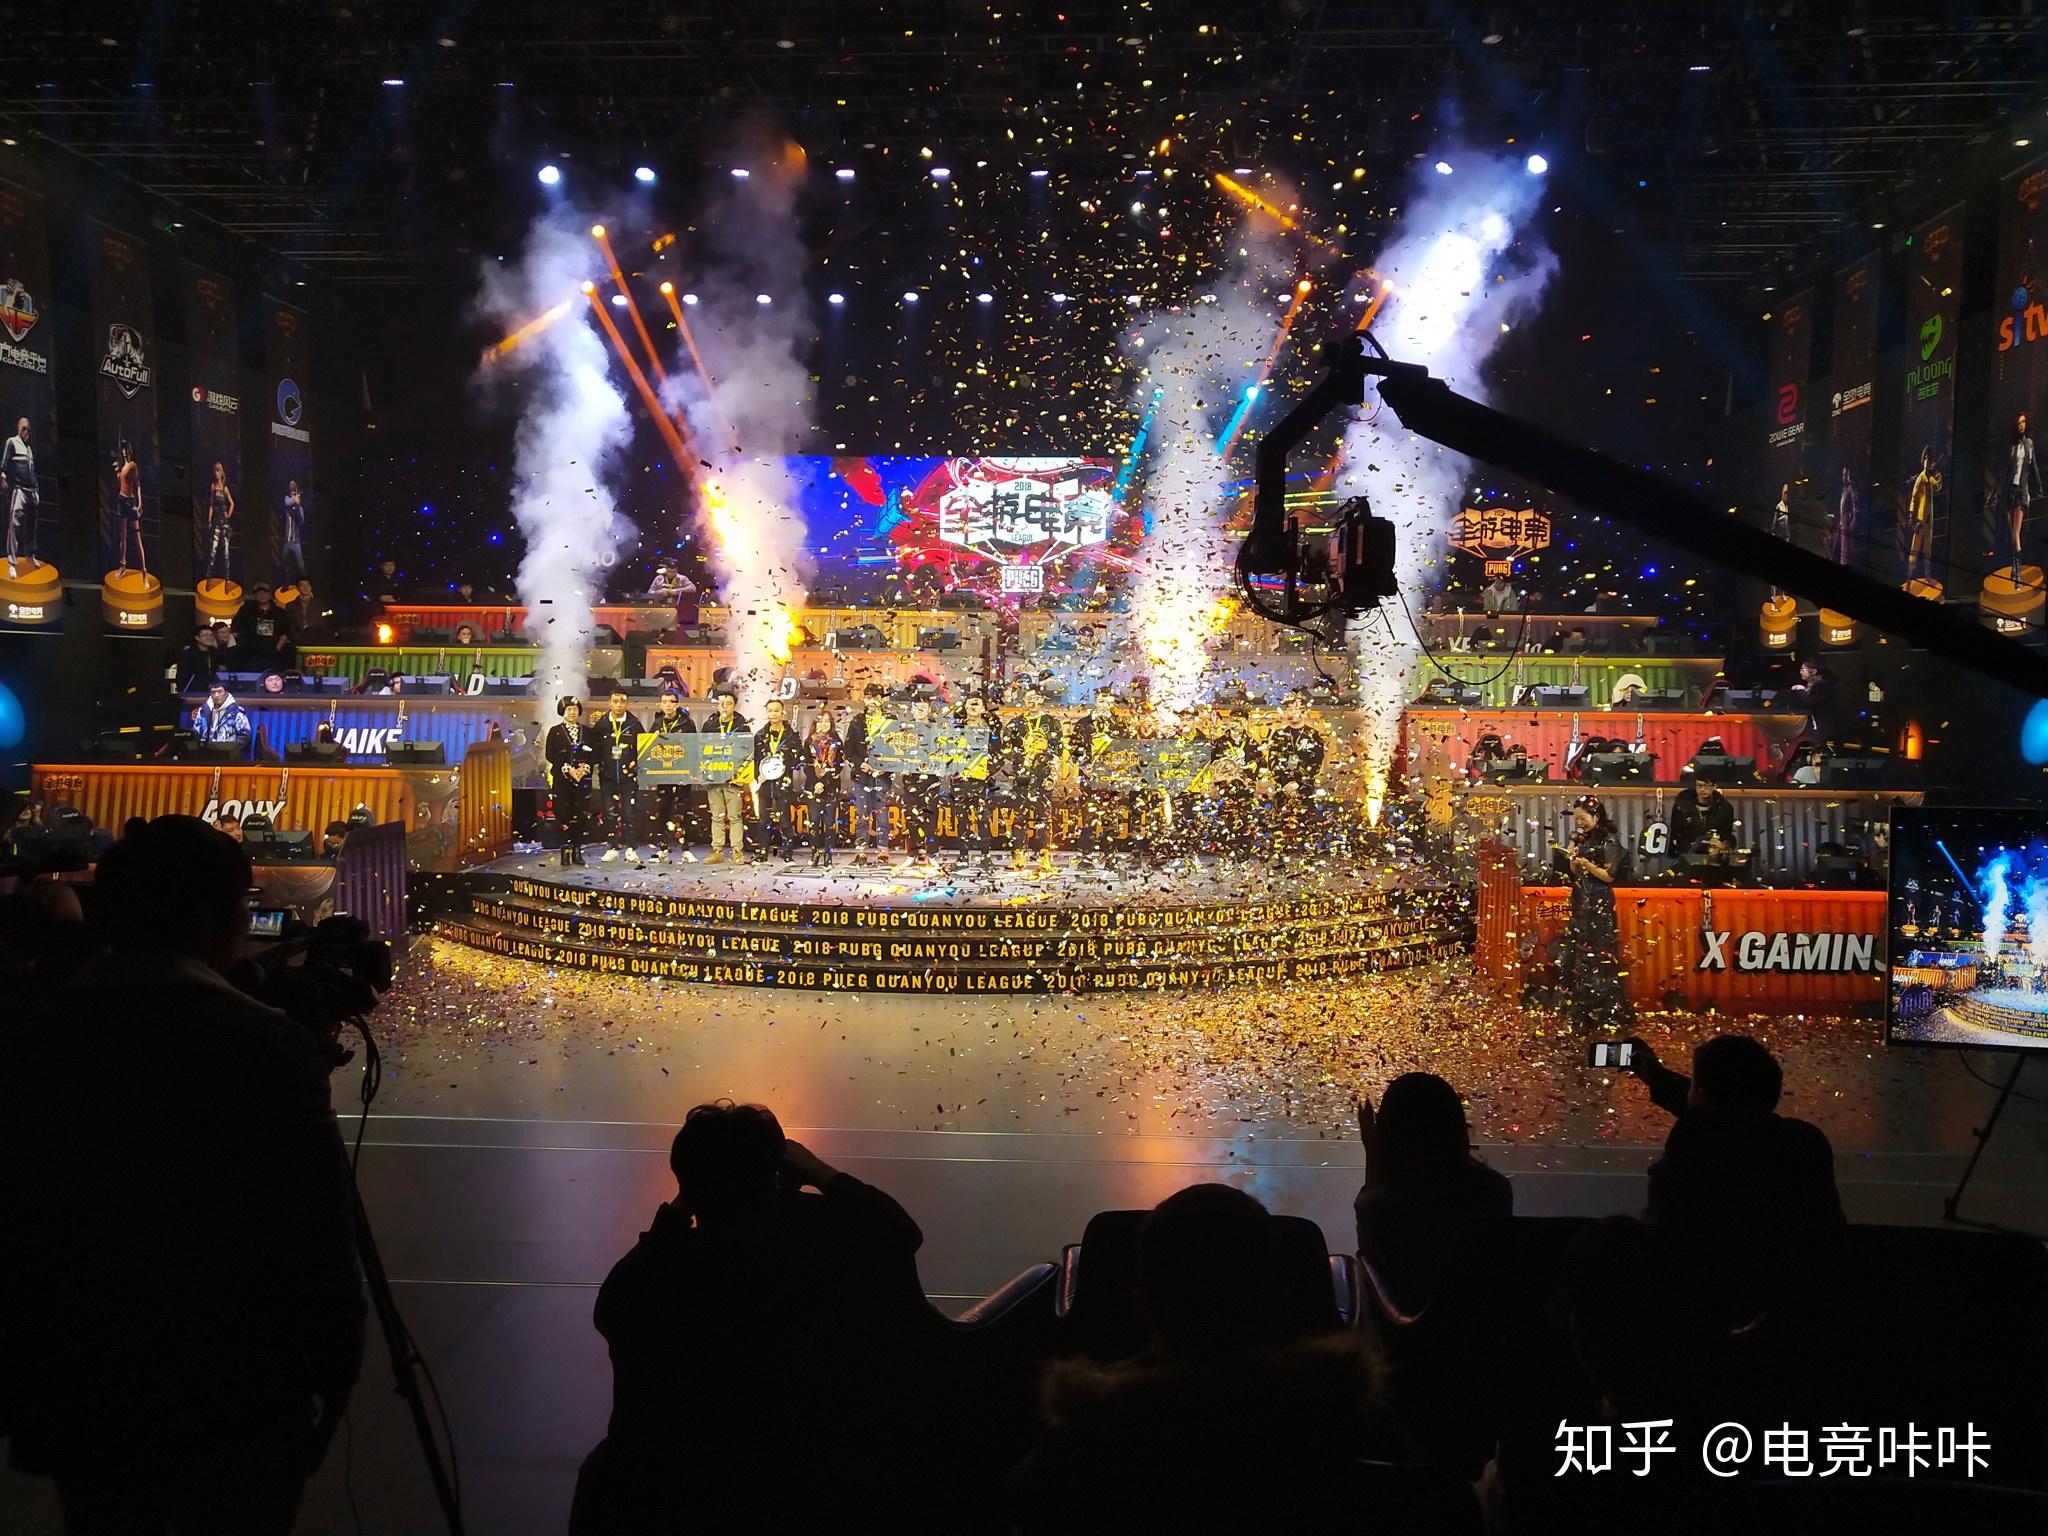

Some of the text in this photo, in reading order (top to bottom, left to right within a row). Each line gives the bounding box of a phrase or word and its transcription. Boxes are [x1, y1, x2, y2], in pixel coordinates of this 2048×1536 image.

[103, 359, 148, 384] AutoFull
[1788, 422, 1804, 437] GEAR
[1014, 481, 1032, 491] 2018
[1011, 533, 1034, 542] LEAGUE
[630, 898, 663, 914] PUBG
[812, 911, 848, 924] 2018
[857, 912, 900, 926] PUBG
[907, 914, 987, 928] QUANYOU
[996, 913, 1057, 928] LEAGUE
[721, 938, 780, 953] LEAGUE
[890, 944, 970, 958] QUANYOU
[1700, 931, 1731, 968] X
[559, 949, 586, 967] 2018
[777, 970, 816, 986] 2018
[876, 974, 957, 990] QUANYOU
[967, 974, 1032, 990] LEAGUE
